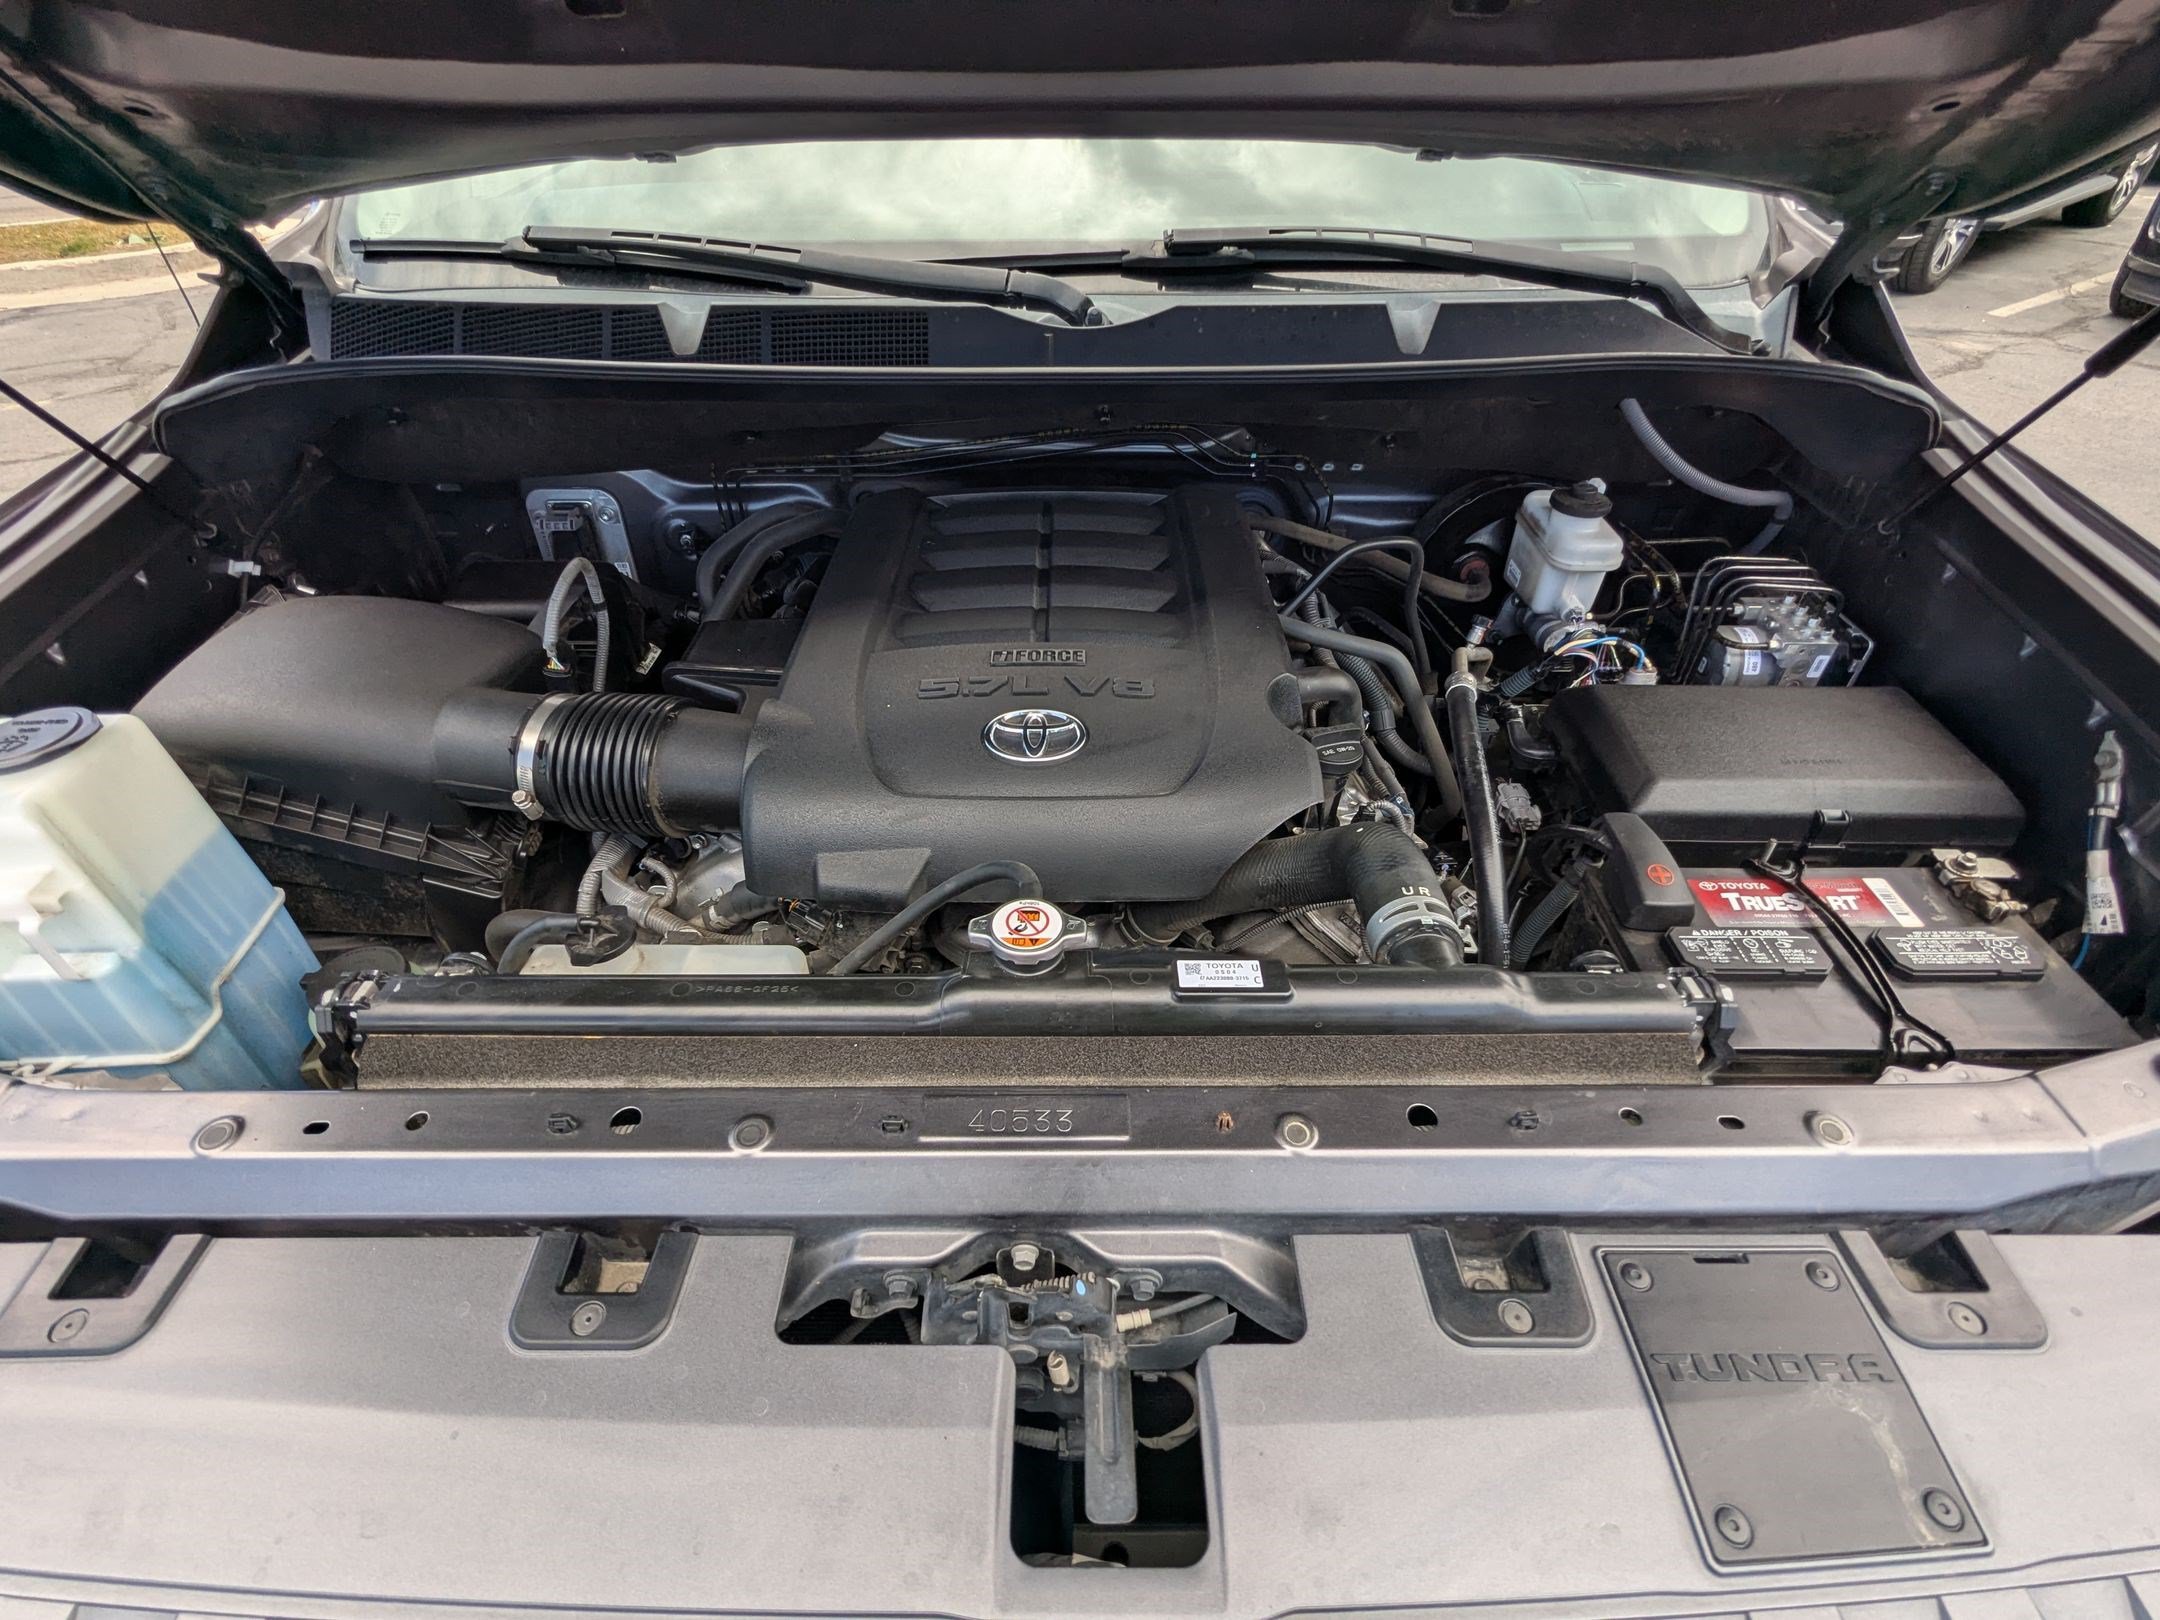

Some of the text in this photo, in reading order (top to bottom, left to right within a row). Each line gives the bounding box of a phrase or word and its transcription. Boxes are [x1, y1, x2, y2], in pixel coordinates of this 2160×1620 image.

[917, 675, 1156, 699] 5.7L V8
[1718, 882, 1770, 891] TOYOTA
[1721, 893, 1859, 912] TRUESRT
[968, 1109, 1074, 1132] 40533
[1650, 1353, 1895, 1383] TUNDRA
